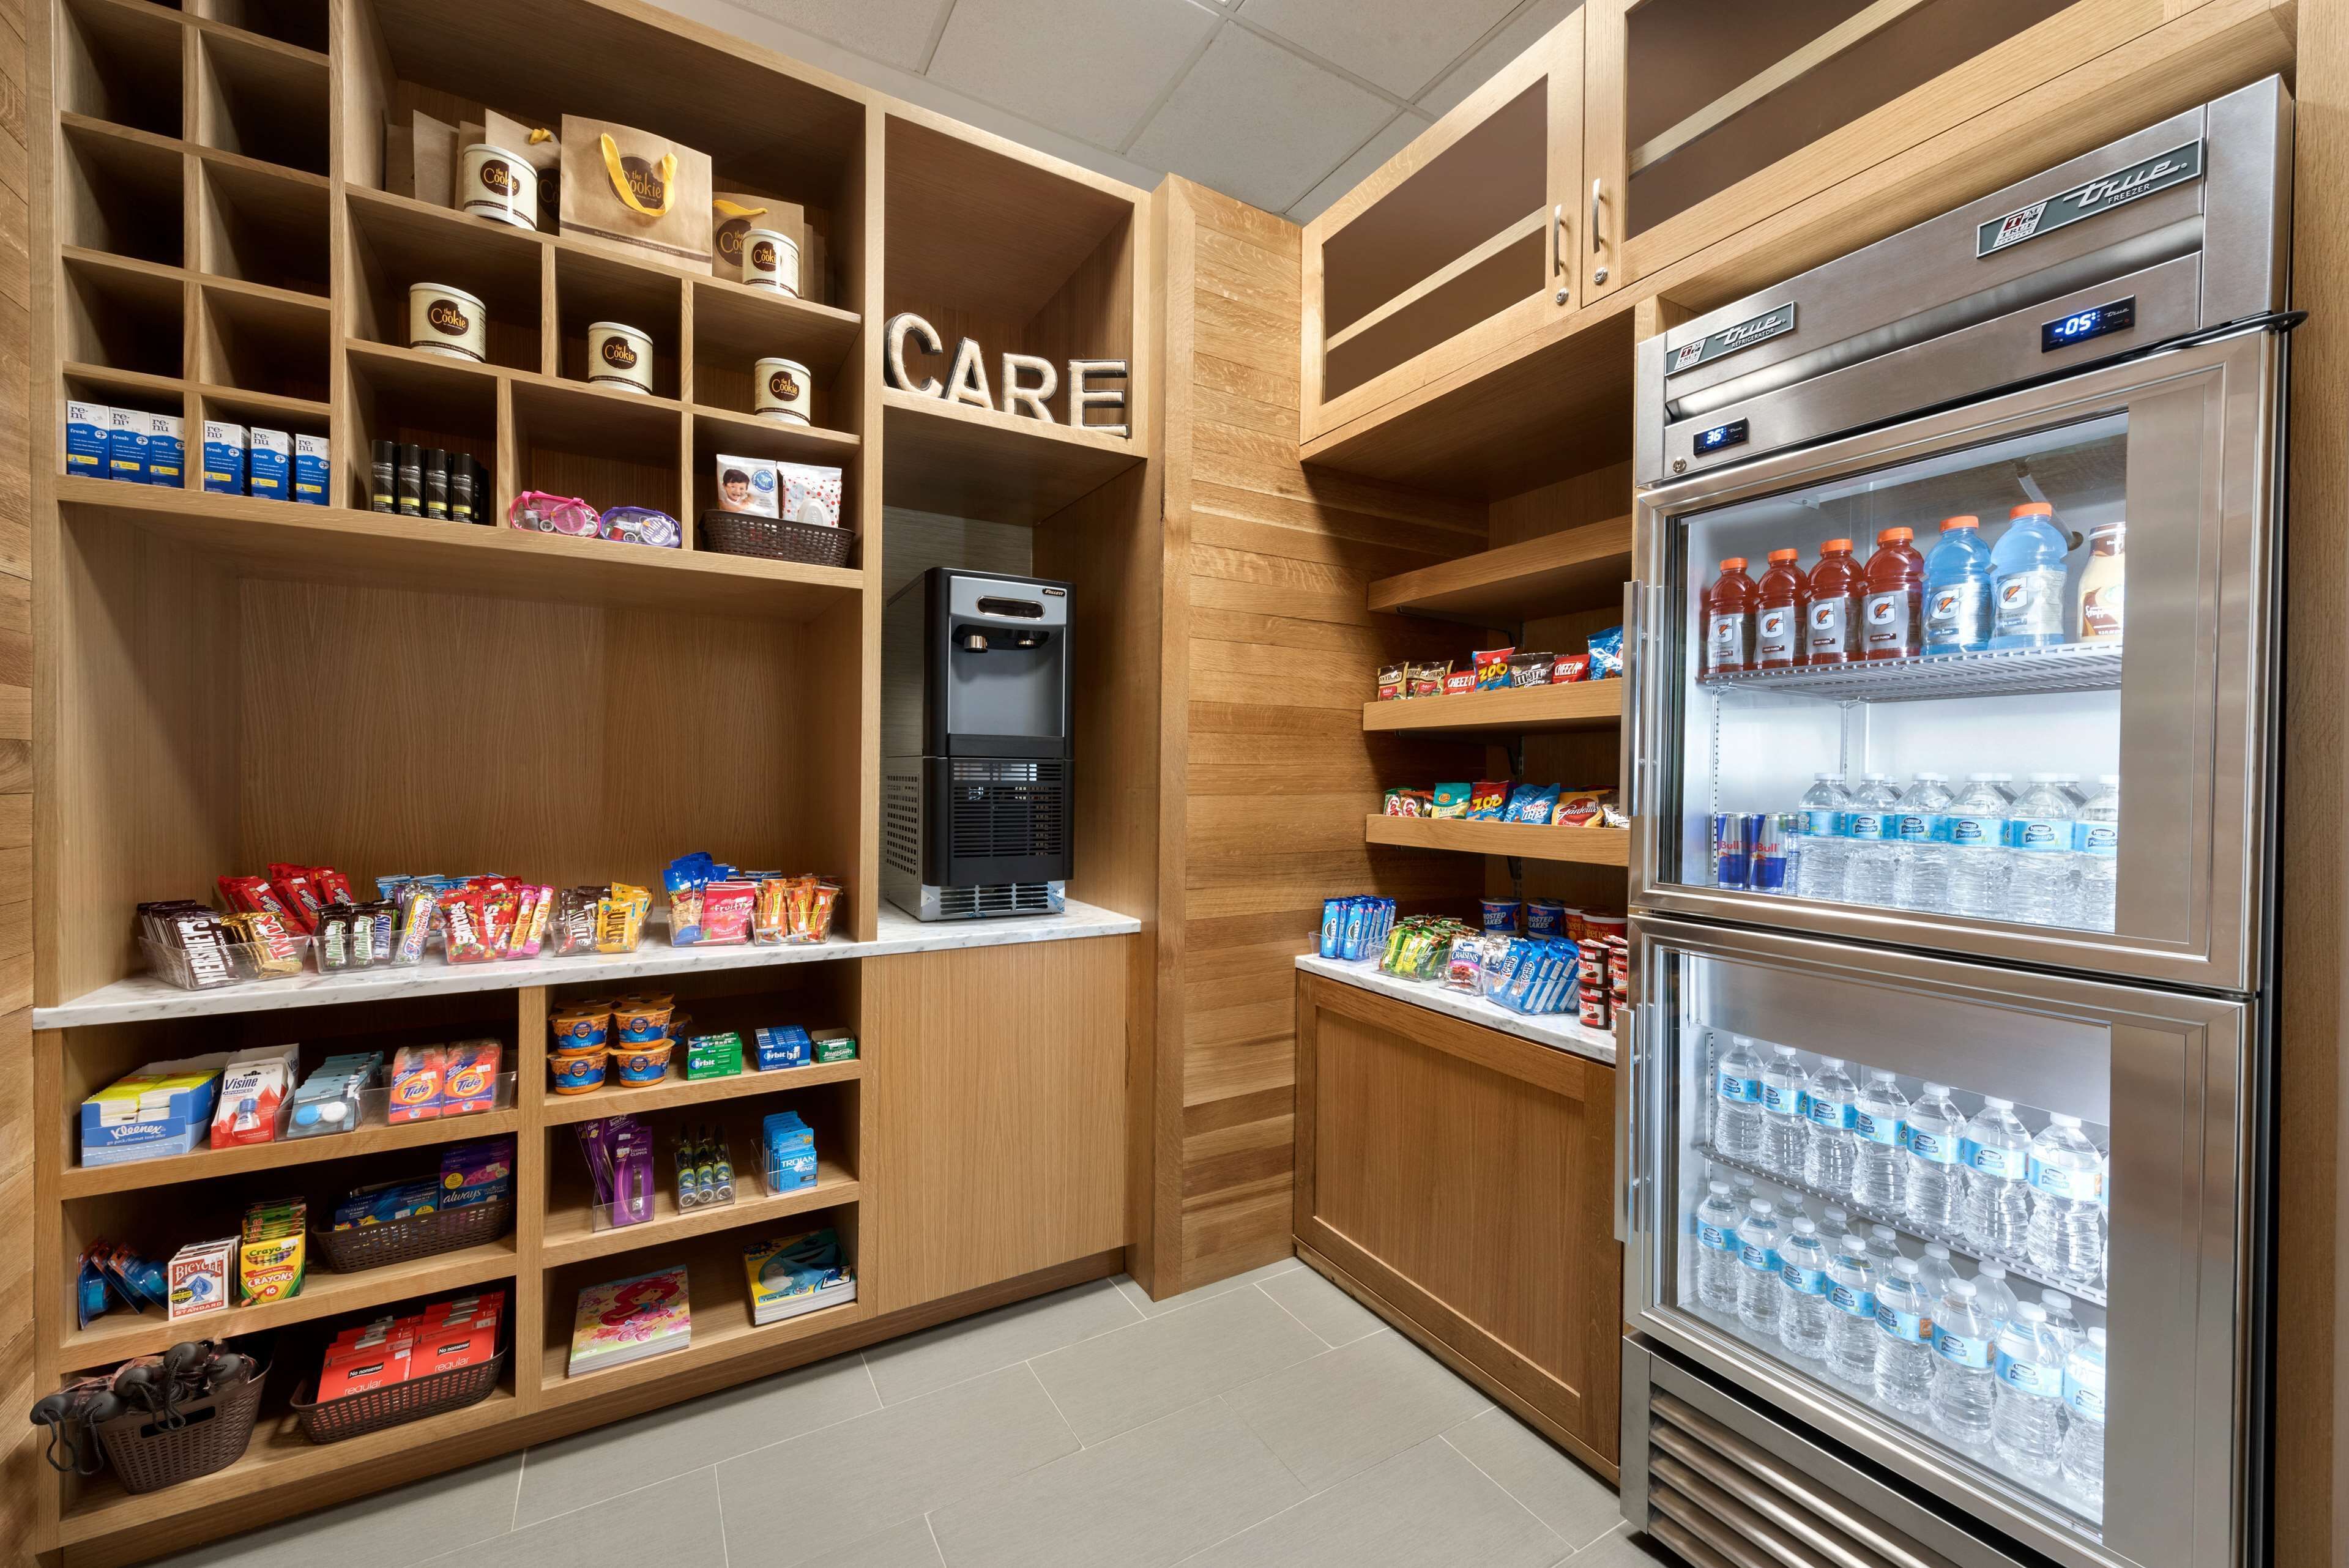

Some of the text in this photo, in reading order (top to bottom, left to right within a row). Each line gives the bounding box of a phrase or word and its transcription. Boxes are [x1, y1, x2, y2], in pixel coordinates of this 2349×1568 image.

[483, 168, 518, 190] Cooke
[632, 169, 642, 181] the
[2107, 183, 2150, 205] FREEZER
[431, 308, 466, 328] Cookie
[1732, 327, 1775, 349] REFRIGERATOR
[605, 344, 635, 362] Cookie
[884, 312, 1128, 438] CARE
[772, 379, 797, 395] Cookie
[1996, 577, 2027, 610] G
[1867, 595, 1896, 625] G
[1930, 589, 1960, 620] G
[1811, 602, 1835, 630] G
[1713, 617, 1733, 643] G
[1761, 611, 1784, 638] G
[1478, 663, 1508, 683] ZOO
[1472, 797, 1503, 812] ZOO
[1757, 843, 1777, 852] Bull
[259, 895, 281, 910] Nutter
[299, 889, 318, 904] Nutter
[450, 901, 477, 945] Skittles
[1483, 912, 1506, 920] ROSTED
[253, 914, 297, 960] TWIX
[177, 918, 229, 985] HERSHEY'S
[1451, 949, 1478, 962] CRAISINS
[225, 1077, 258, 1090] Visine
[456, 1078, 481, 1092] Tide
[404, 1084, 430, 1099] Tide
[111, 1125, 163, 1139] Kleenex
[781, 1155, 815, 1167] TROJAN
[442, 1189, 482, 1204] always
[176, 1260, 221, 1284] BICYCLE
[247, 1272, 294, 1288] CRAYONS
[266, 1287, 277, 1295] 16
[175, 1301, 221, 1315] STANDARD
[447, 1342, 469, 1351] nonsense
[361, 1364, 383, 1375] nonsense
[434, 1357, 470, 1372] regular
[344, 1380, 382, 1395] regular
